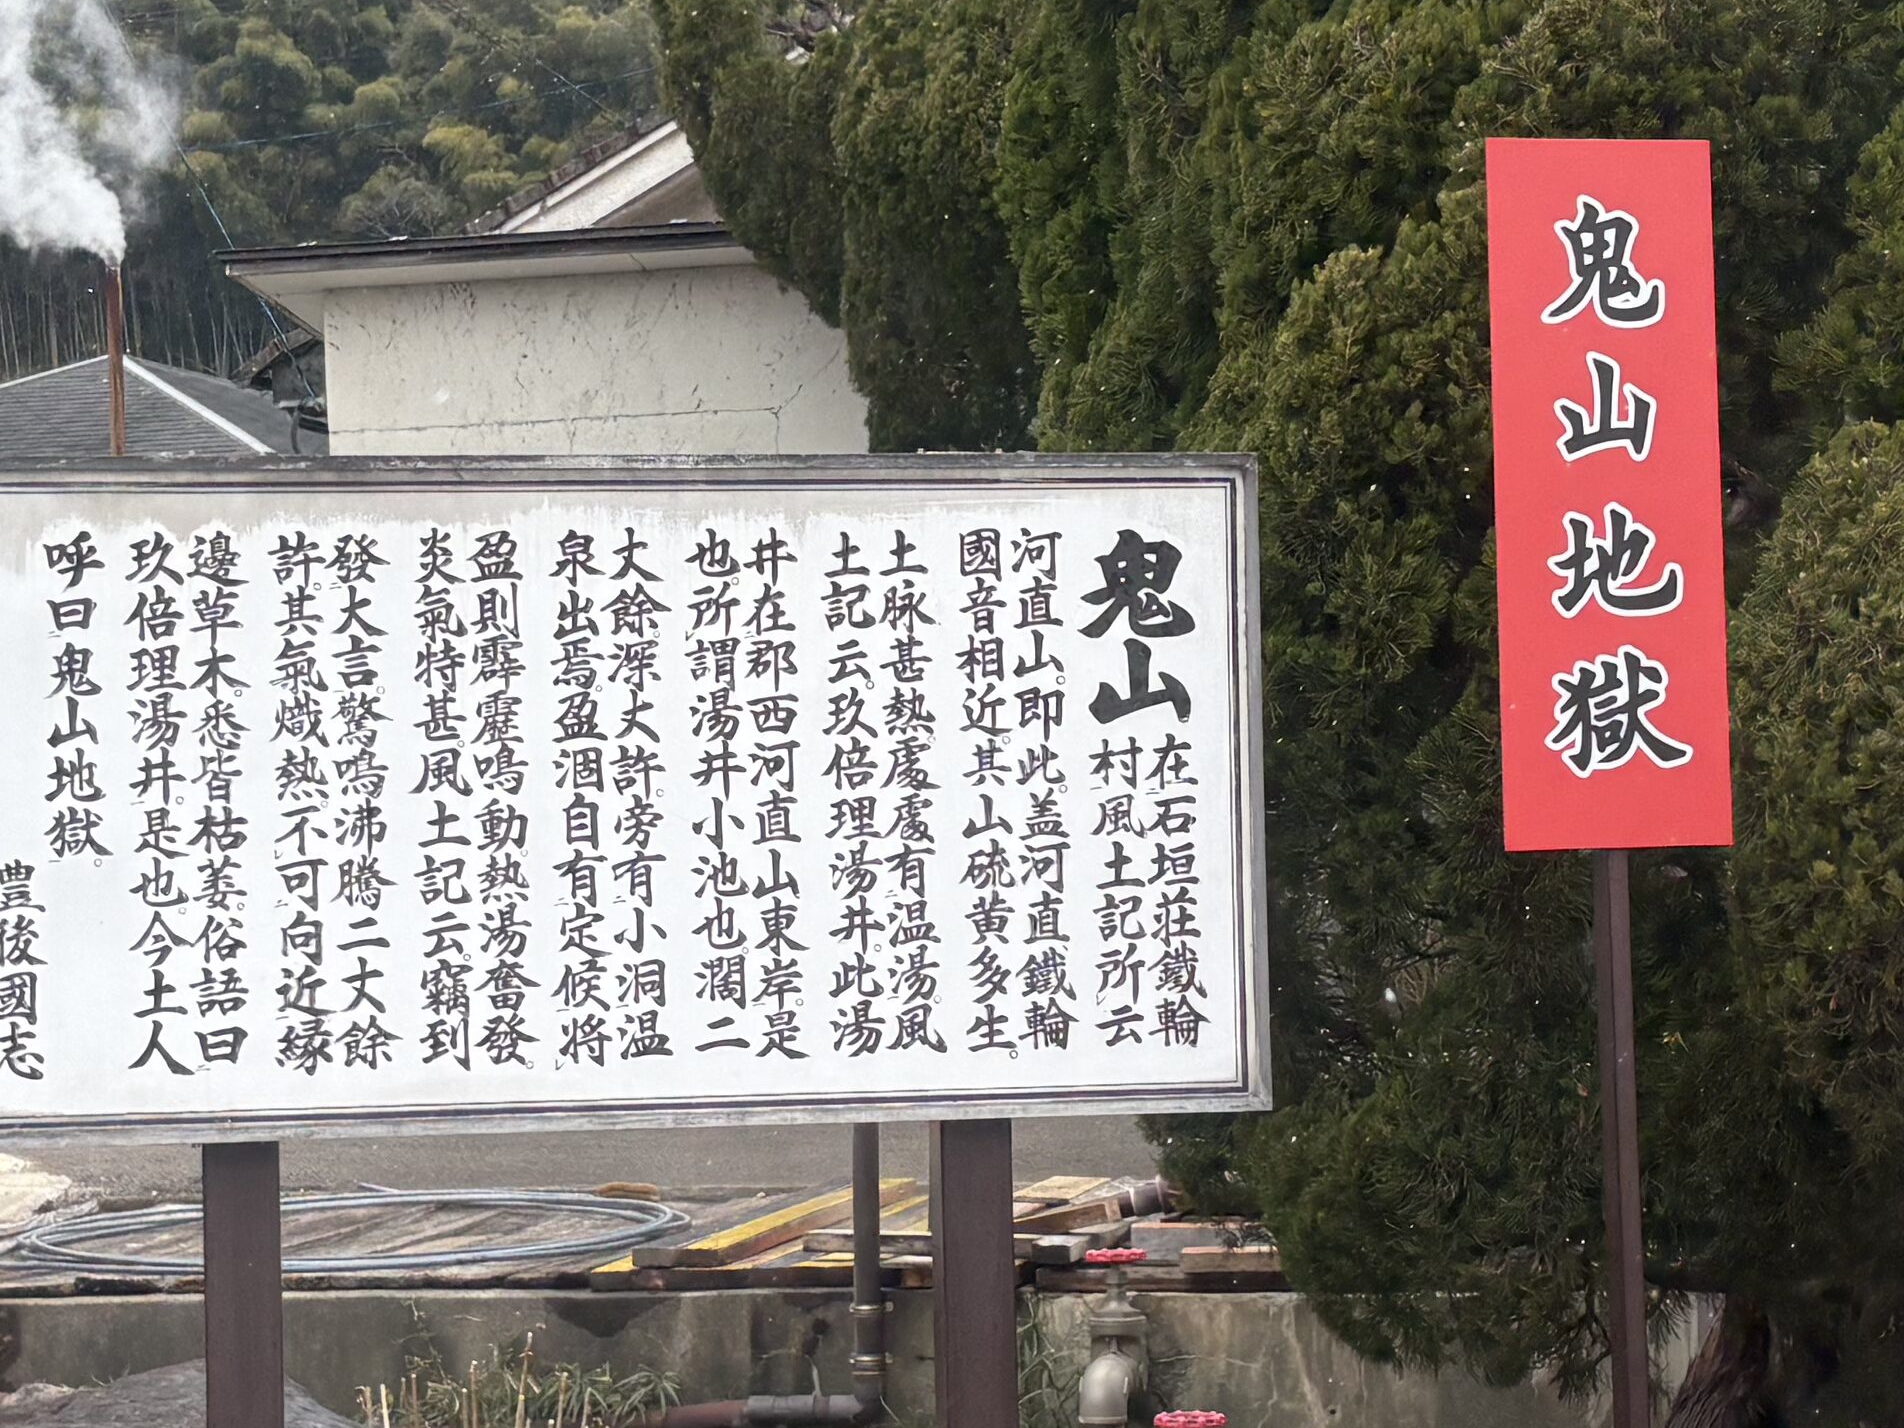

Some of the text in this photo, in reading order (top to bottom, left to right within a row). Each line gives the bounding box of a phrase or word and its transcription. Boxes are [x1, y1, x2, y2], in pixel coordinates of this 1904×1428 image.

[1077, 529, 1196, 724] 鬼山
[1541, 194, 1693, 778] 鬼山地獄
